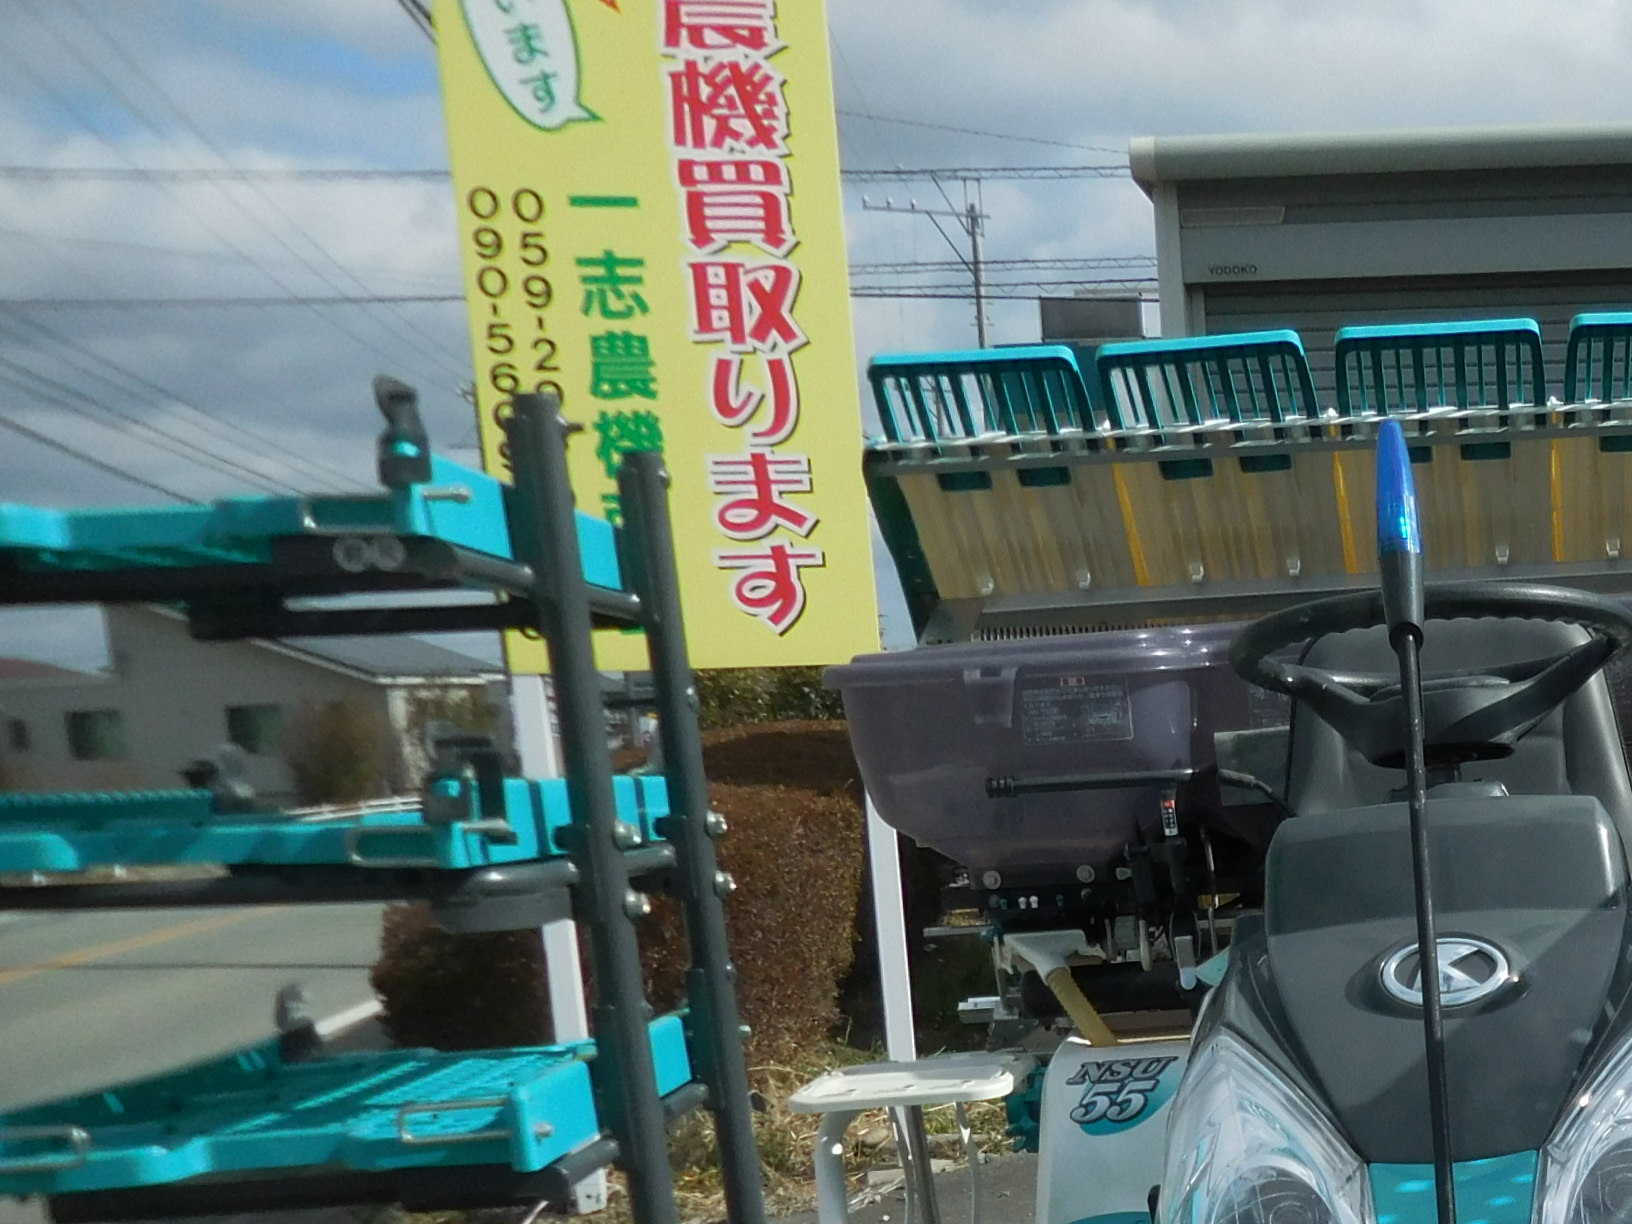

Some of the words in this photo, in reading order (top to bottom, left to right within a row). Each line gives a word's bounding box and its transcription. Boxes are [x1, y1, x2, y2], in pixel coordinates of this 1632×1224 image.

[1208, 264, 1258, 276] YODOKO
[567, 195, 665, 528] 一志農機
[1065, 1055, 1180, 1086] NSU
[1069, 1079, 1160, 1125] 55
